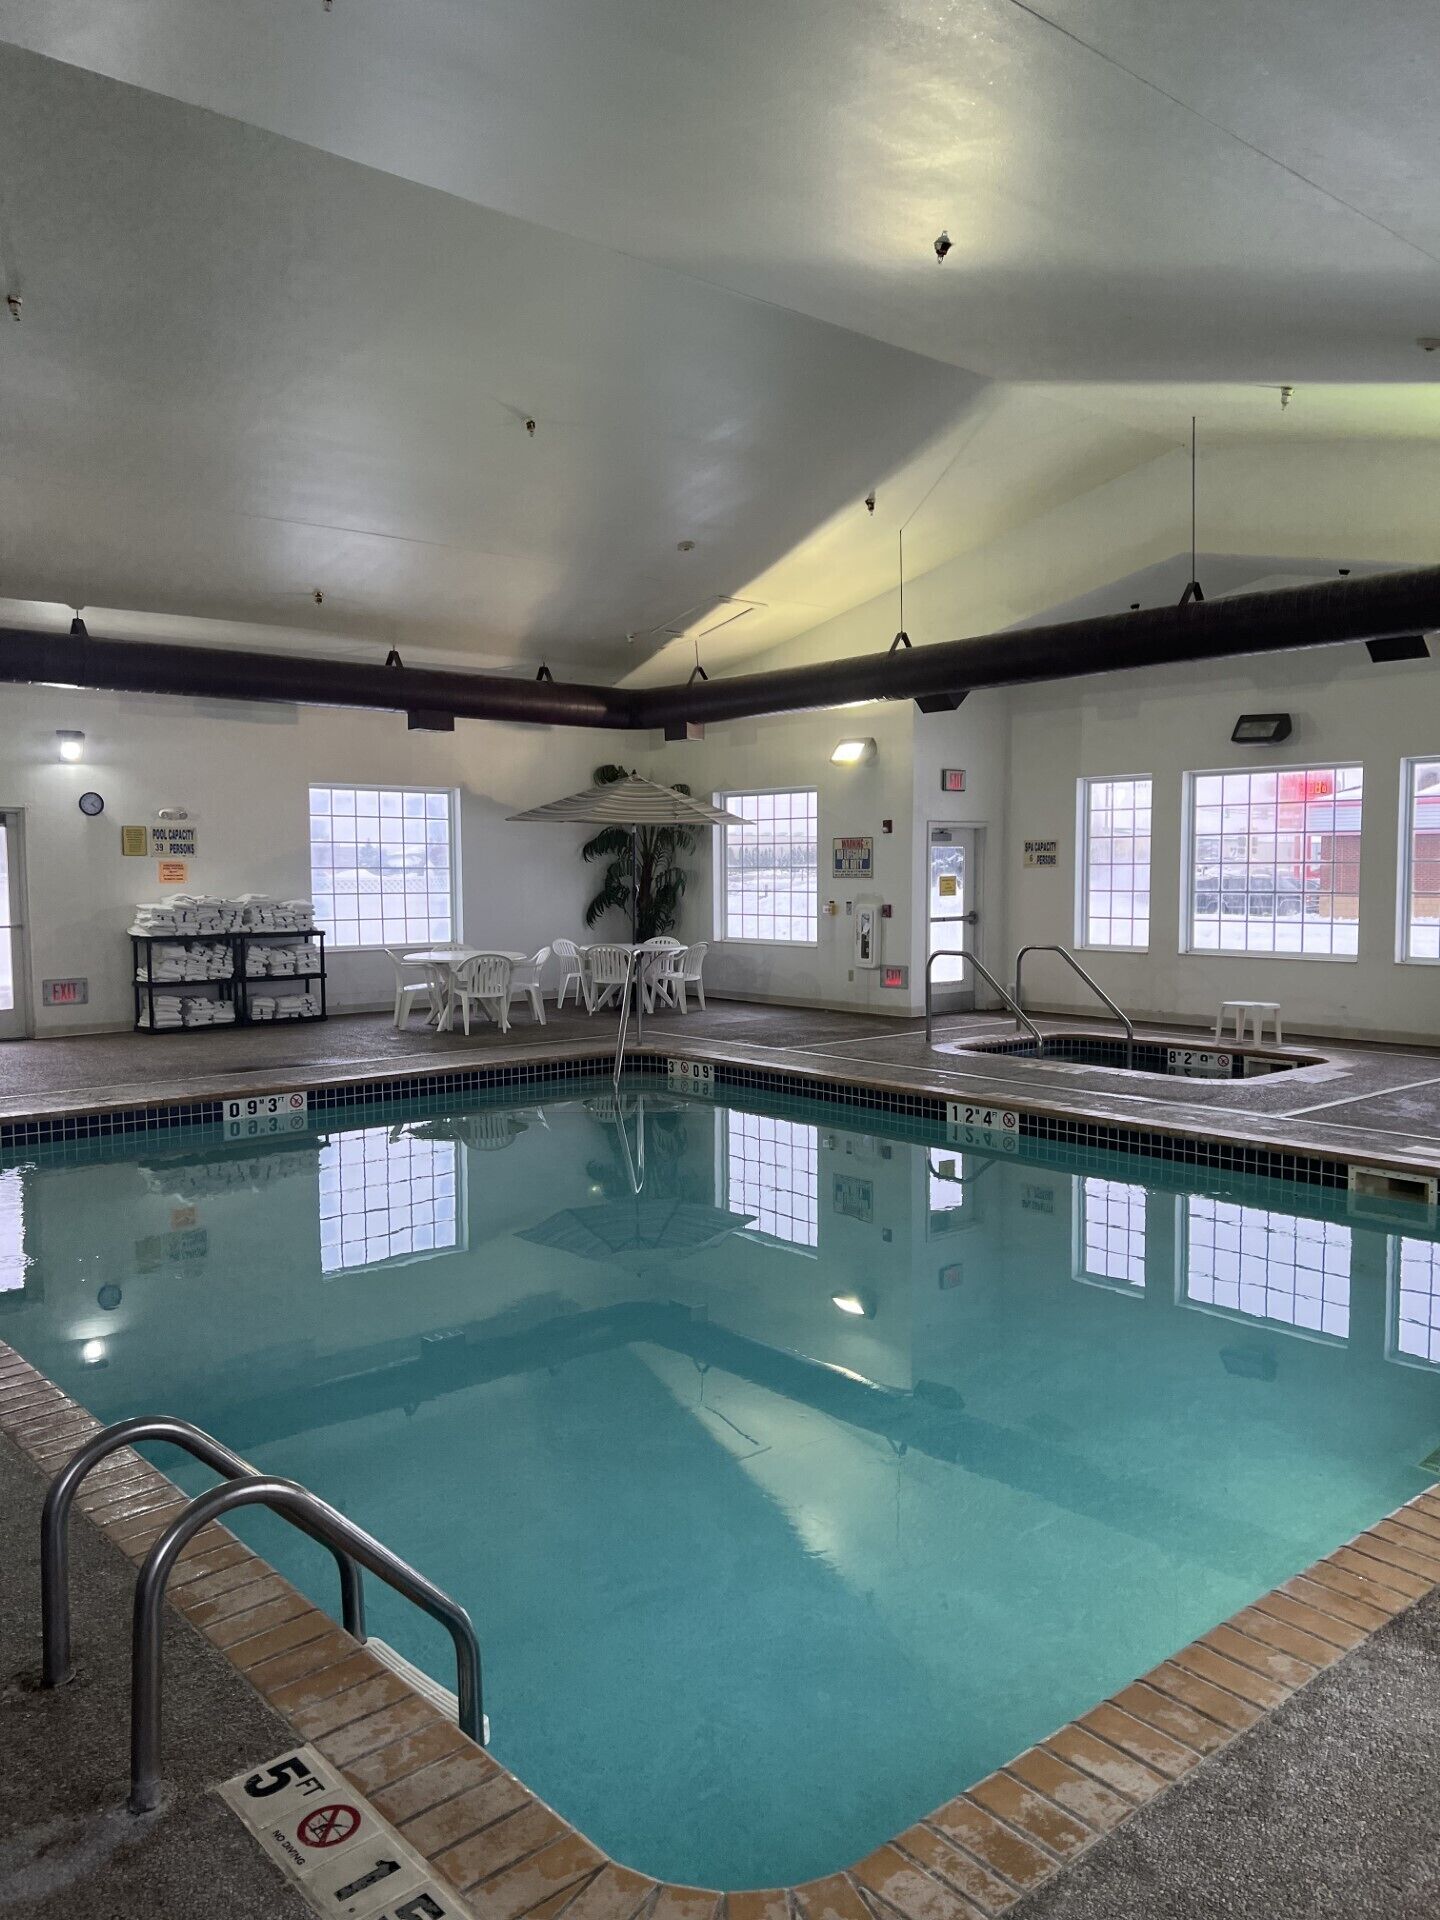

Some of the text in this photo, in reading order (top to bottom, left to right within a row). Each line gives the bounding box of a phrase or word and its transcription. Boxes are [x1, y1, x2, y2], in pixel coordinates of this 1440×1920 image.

[152, 828, 194, 840] POOL CAPACITY
[155, 843, 195, 854] 39 PERSONS
[1025, 841, 1056, 852] SPA CAPACITY
[1037, 854, 1056, 864] PERSONS
[52, 982, 78, 1001] EXIT
[272, 1829, 306, 1866] NO DIVING
